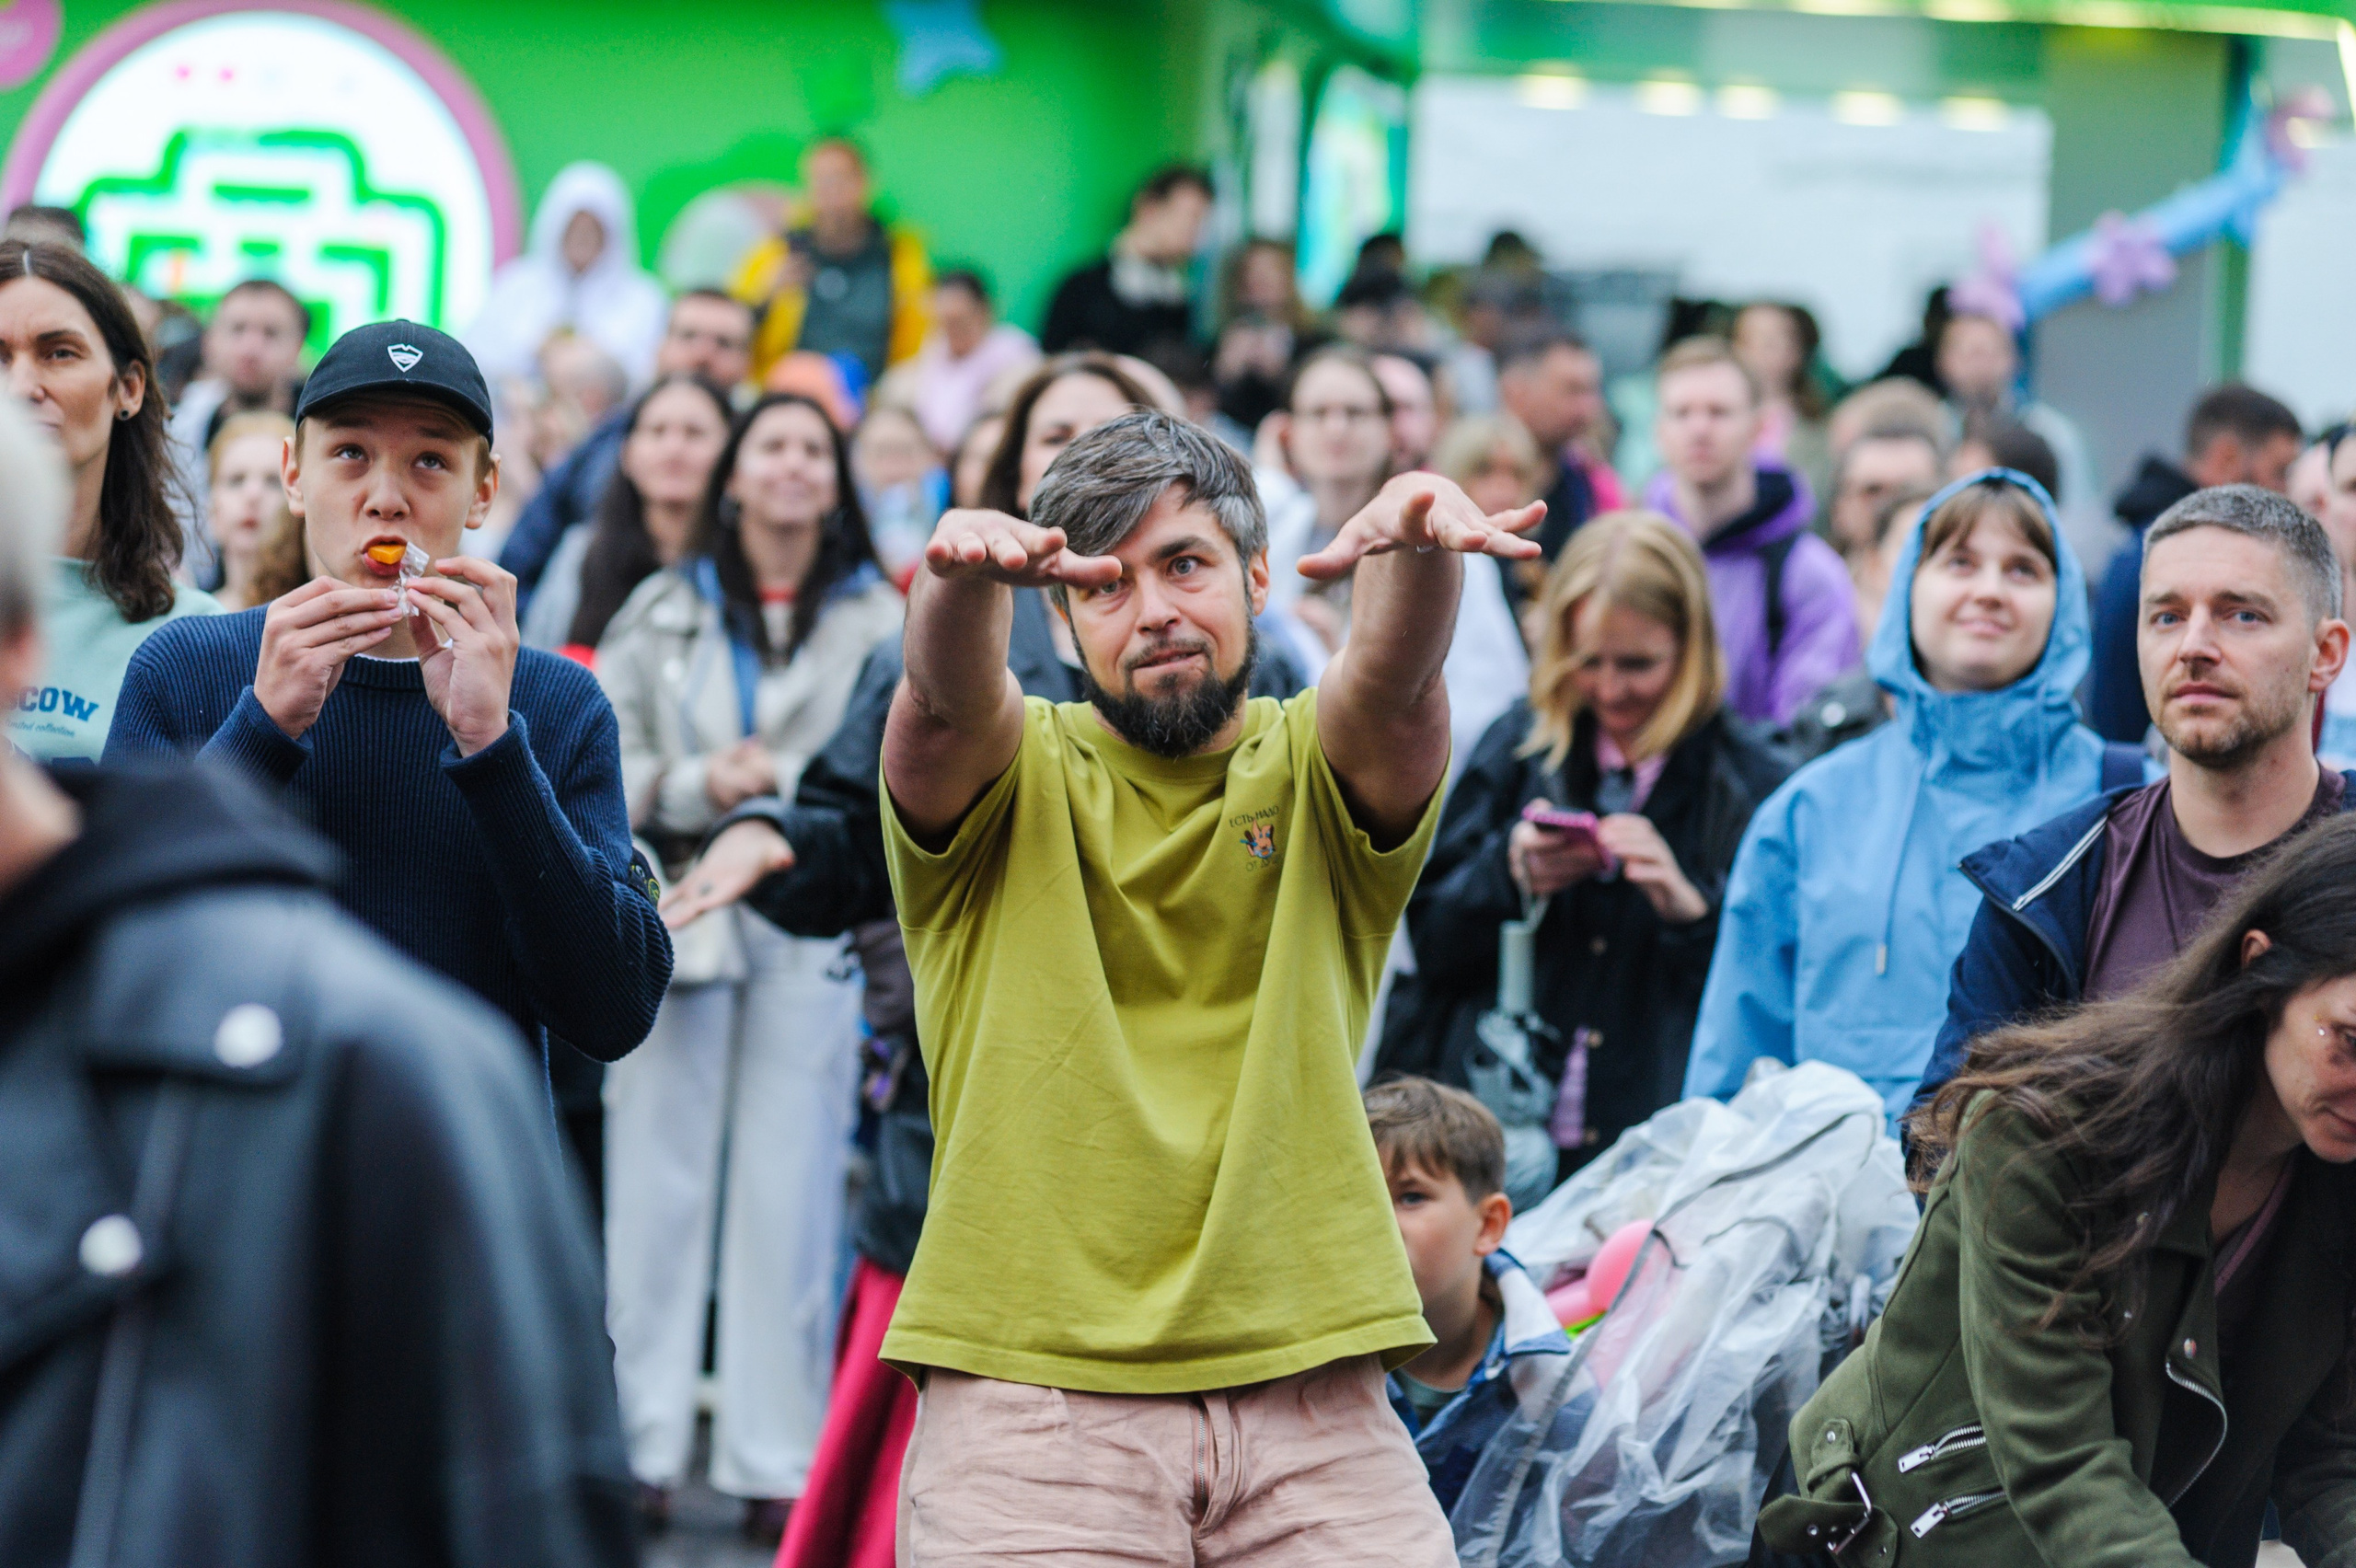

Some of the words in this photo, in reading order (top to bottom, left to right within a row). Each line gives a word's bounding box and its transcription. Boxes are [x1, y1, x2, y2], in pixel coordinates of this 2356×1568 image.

[36, 722, 75, 737] collection
[1230, 814, 1254, 828] ЕСТЬ
[1255, 805, 1279, 819] НАДО
